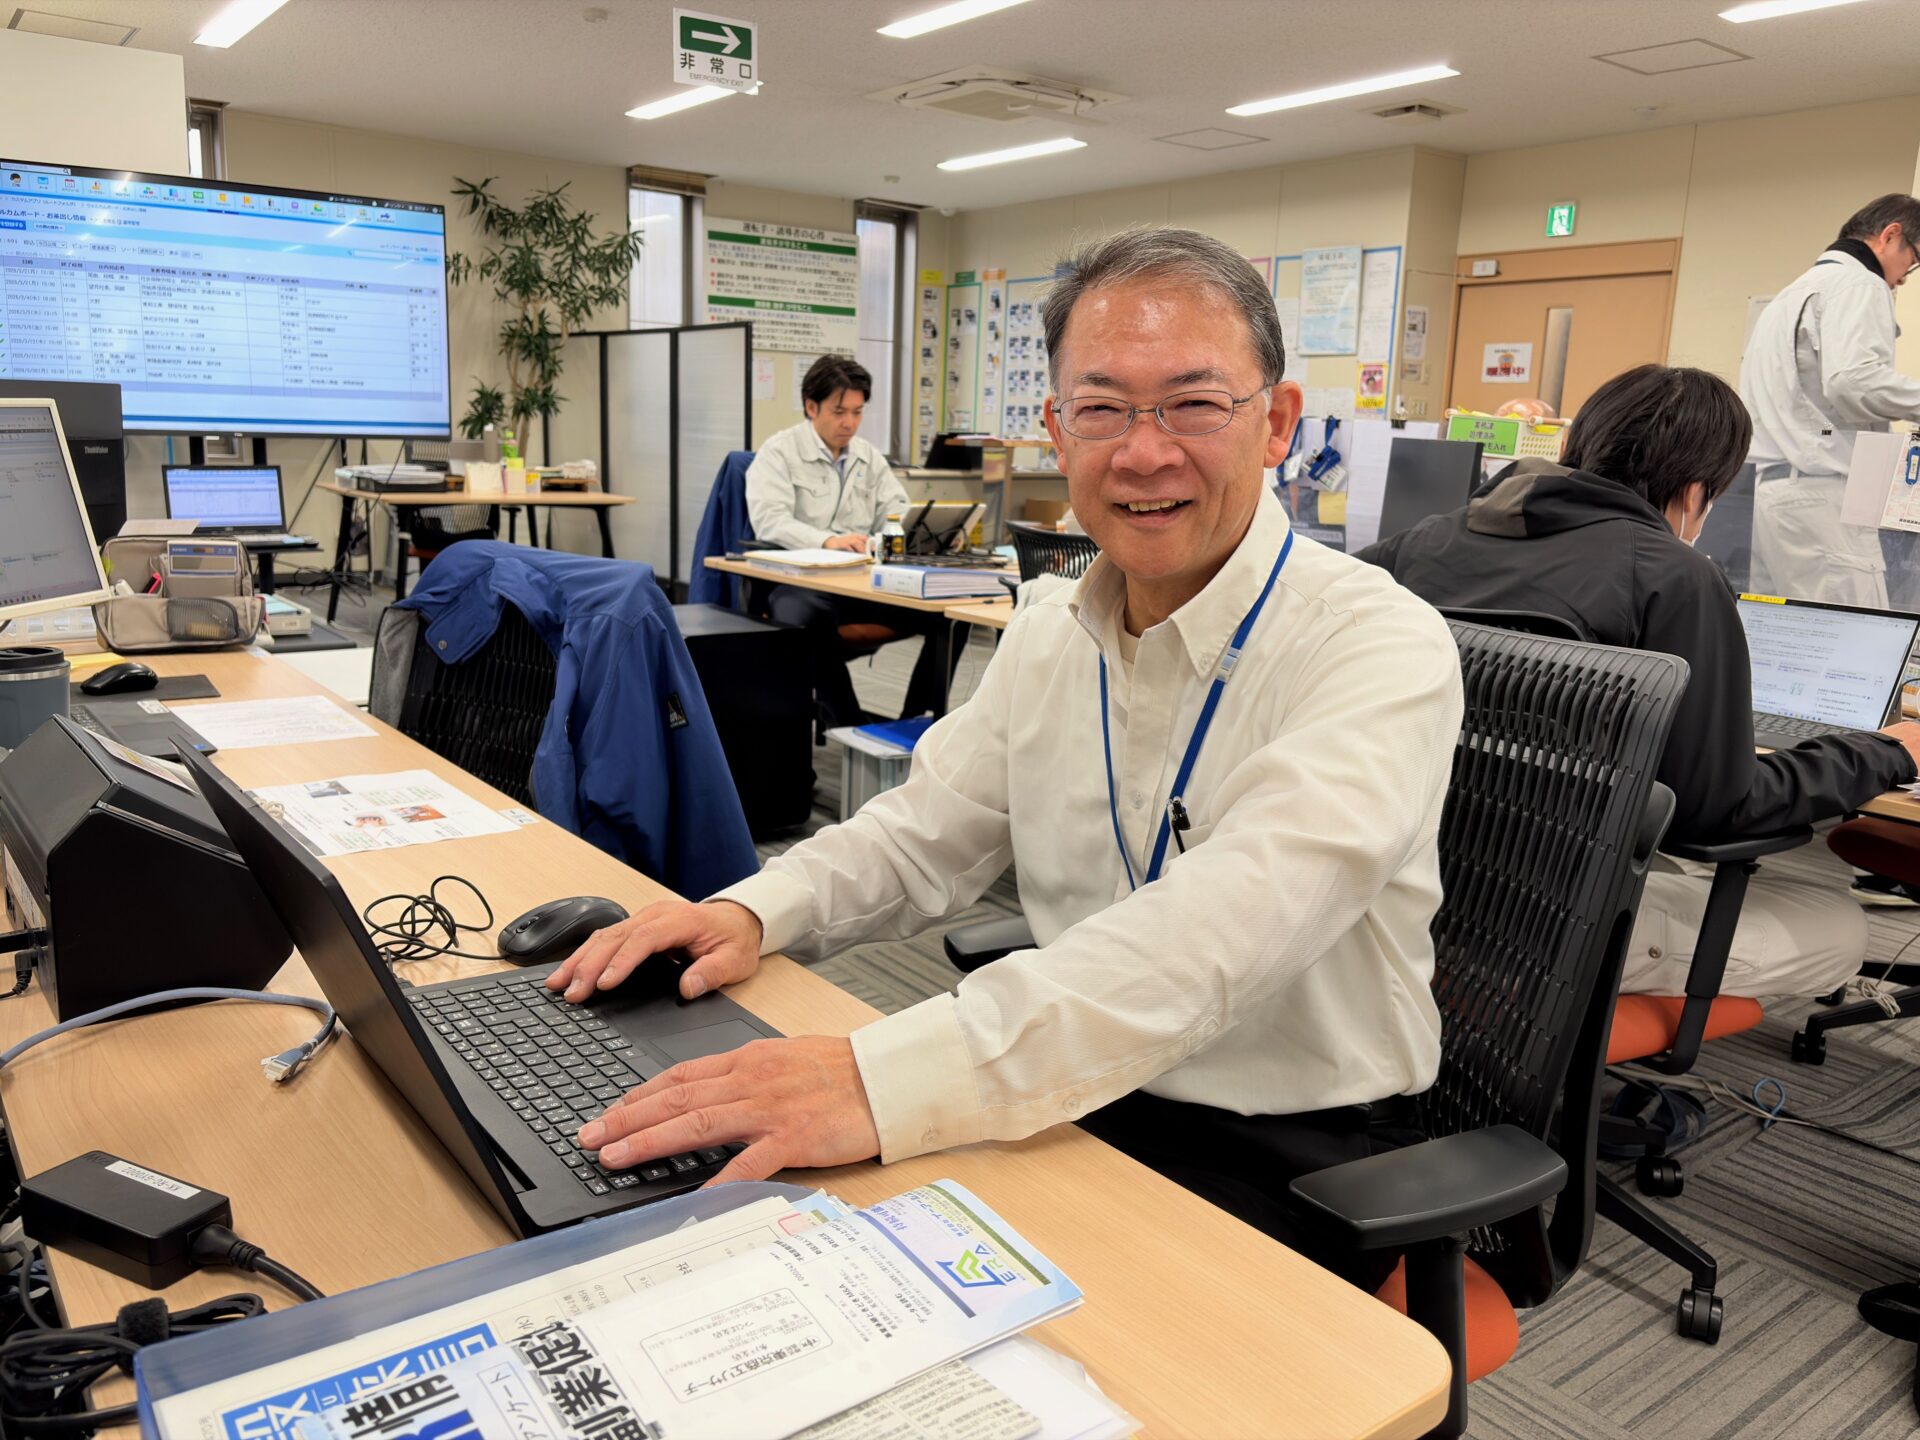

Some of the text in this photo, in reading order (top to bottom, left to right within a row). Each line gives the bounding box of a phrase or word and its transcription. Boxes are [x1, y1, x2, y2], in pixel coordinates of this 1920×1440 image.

[680, 52, 752, 80] 非常口
[689, 73, 729, 85] EMERGENCY
[974, 1244, 1016, 1282] ERA
[892, 1292, 929, 1322] データを読む
[708, 1318, 754, 1339] つくば支店
[727, 1342, 769, 1362] 水戸支店
